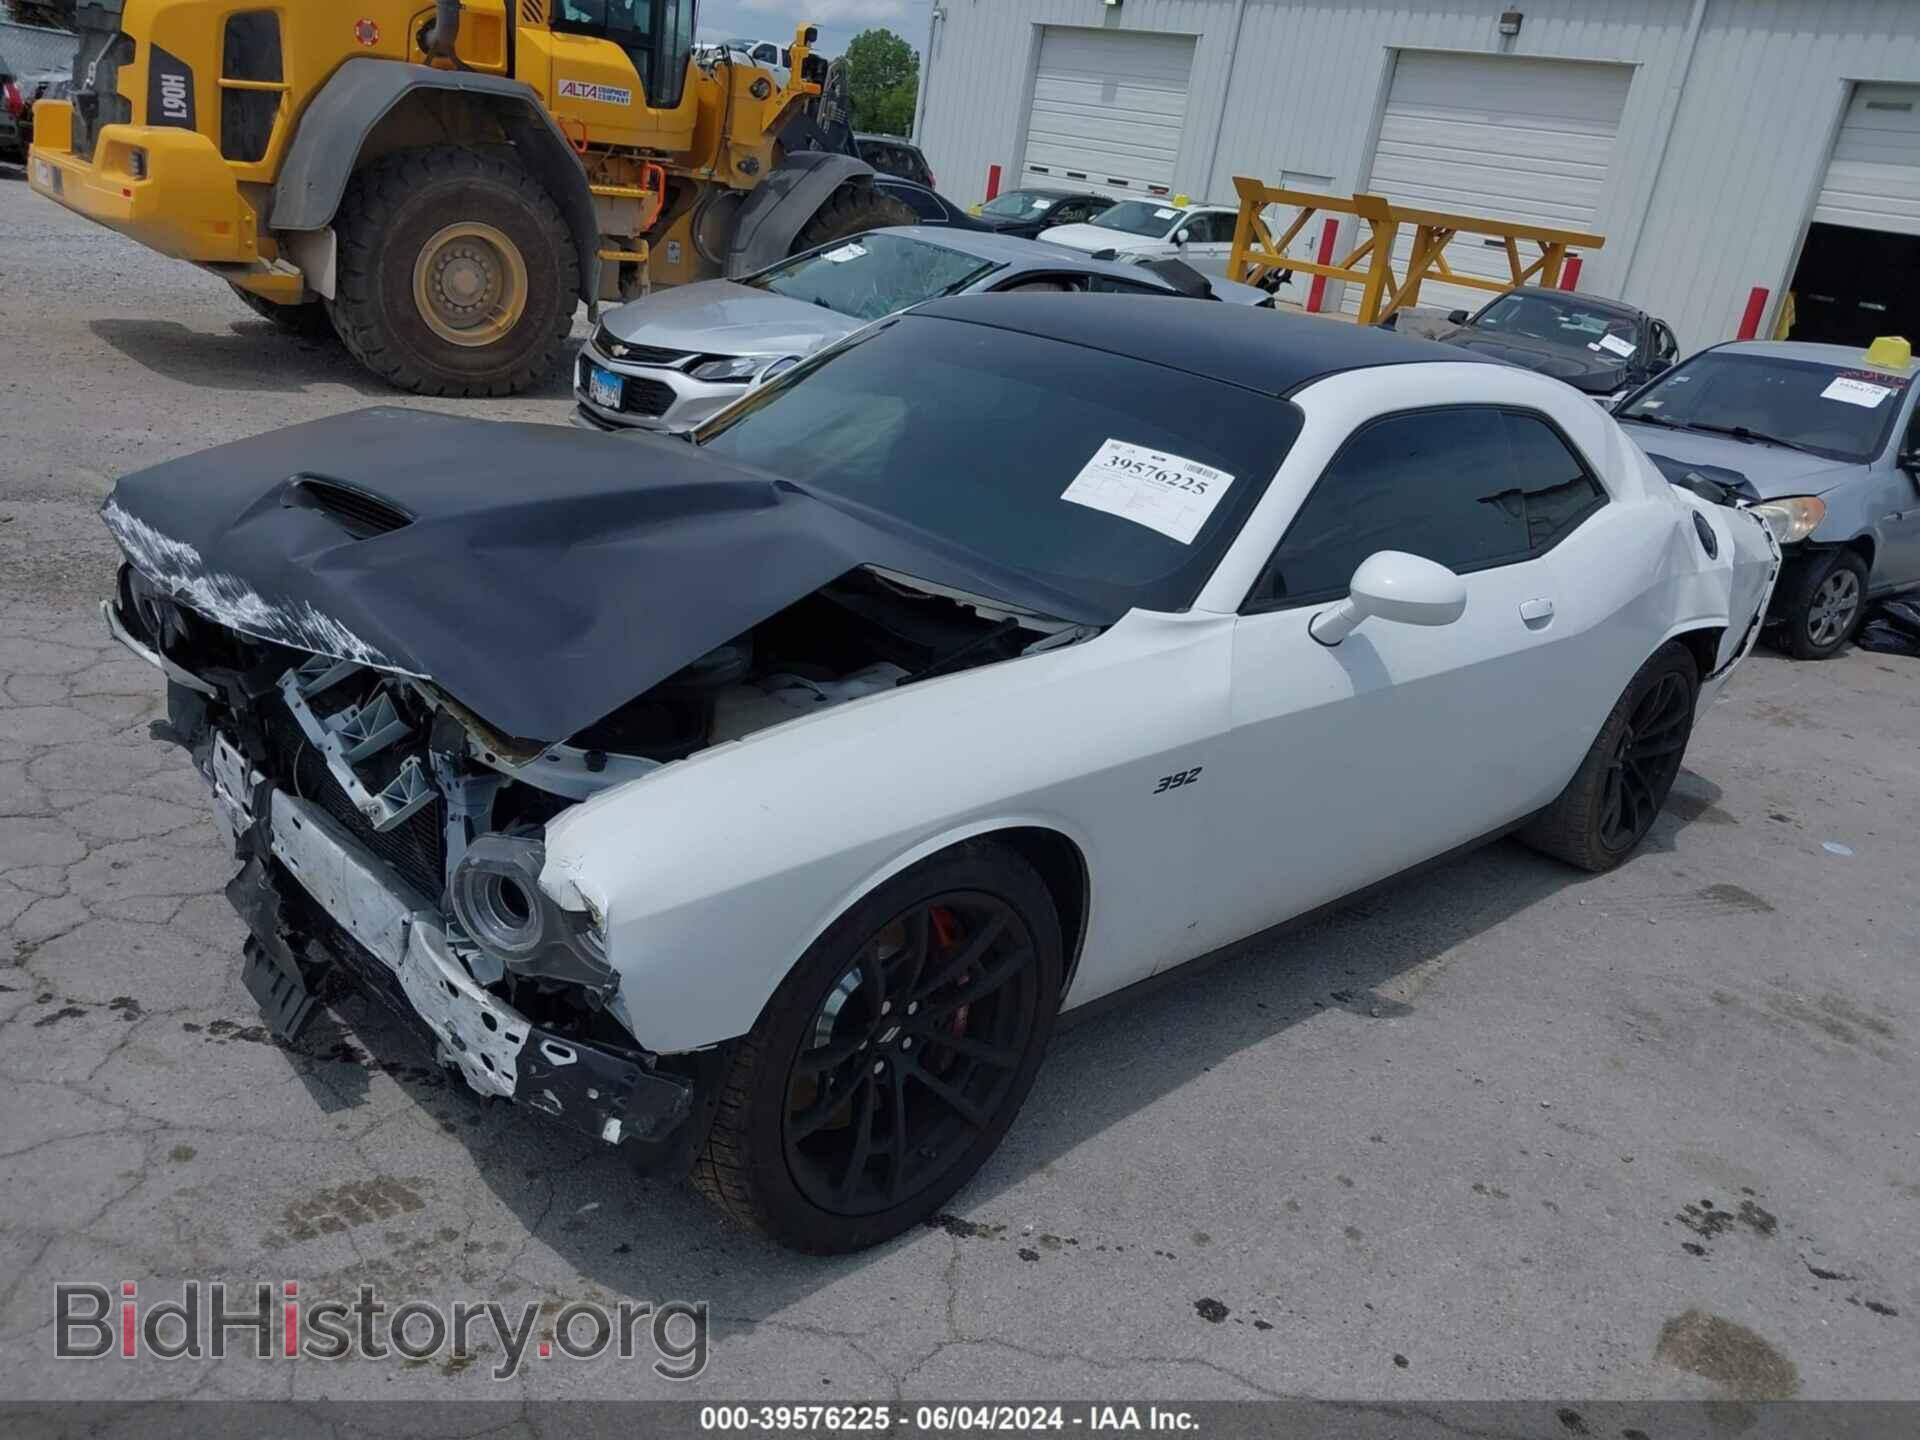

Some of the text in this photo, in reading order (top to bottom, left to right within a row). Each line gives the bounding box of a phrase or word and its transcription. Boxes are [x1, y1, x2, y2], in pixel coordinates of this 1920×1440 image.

[161, 73, 187, 118] L90H
[561, 81, 597, 99] ALTA
[1103, 455, 1209, 496] 39576225
[1153, 766, 1203, 795] 392
